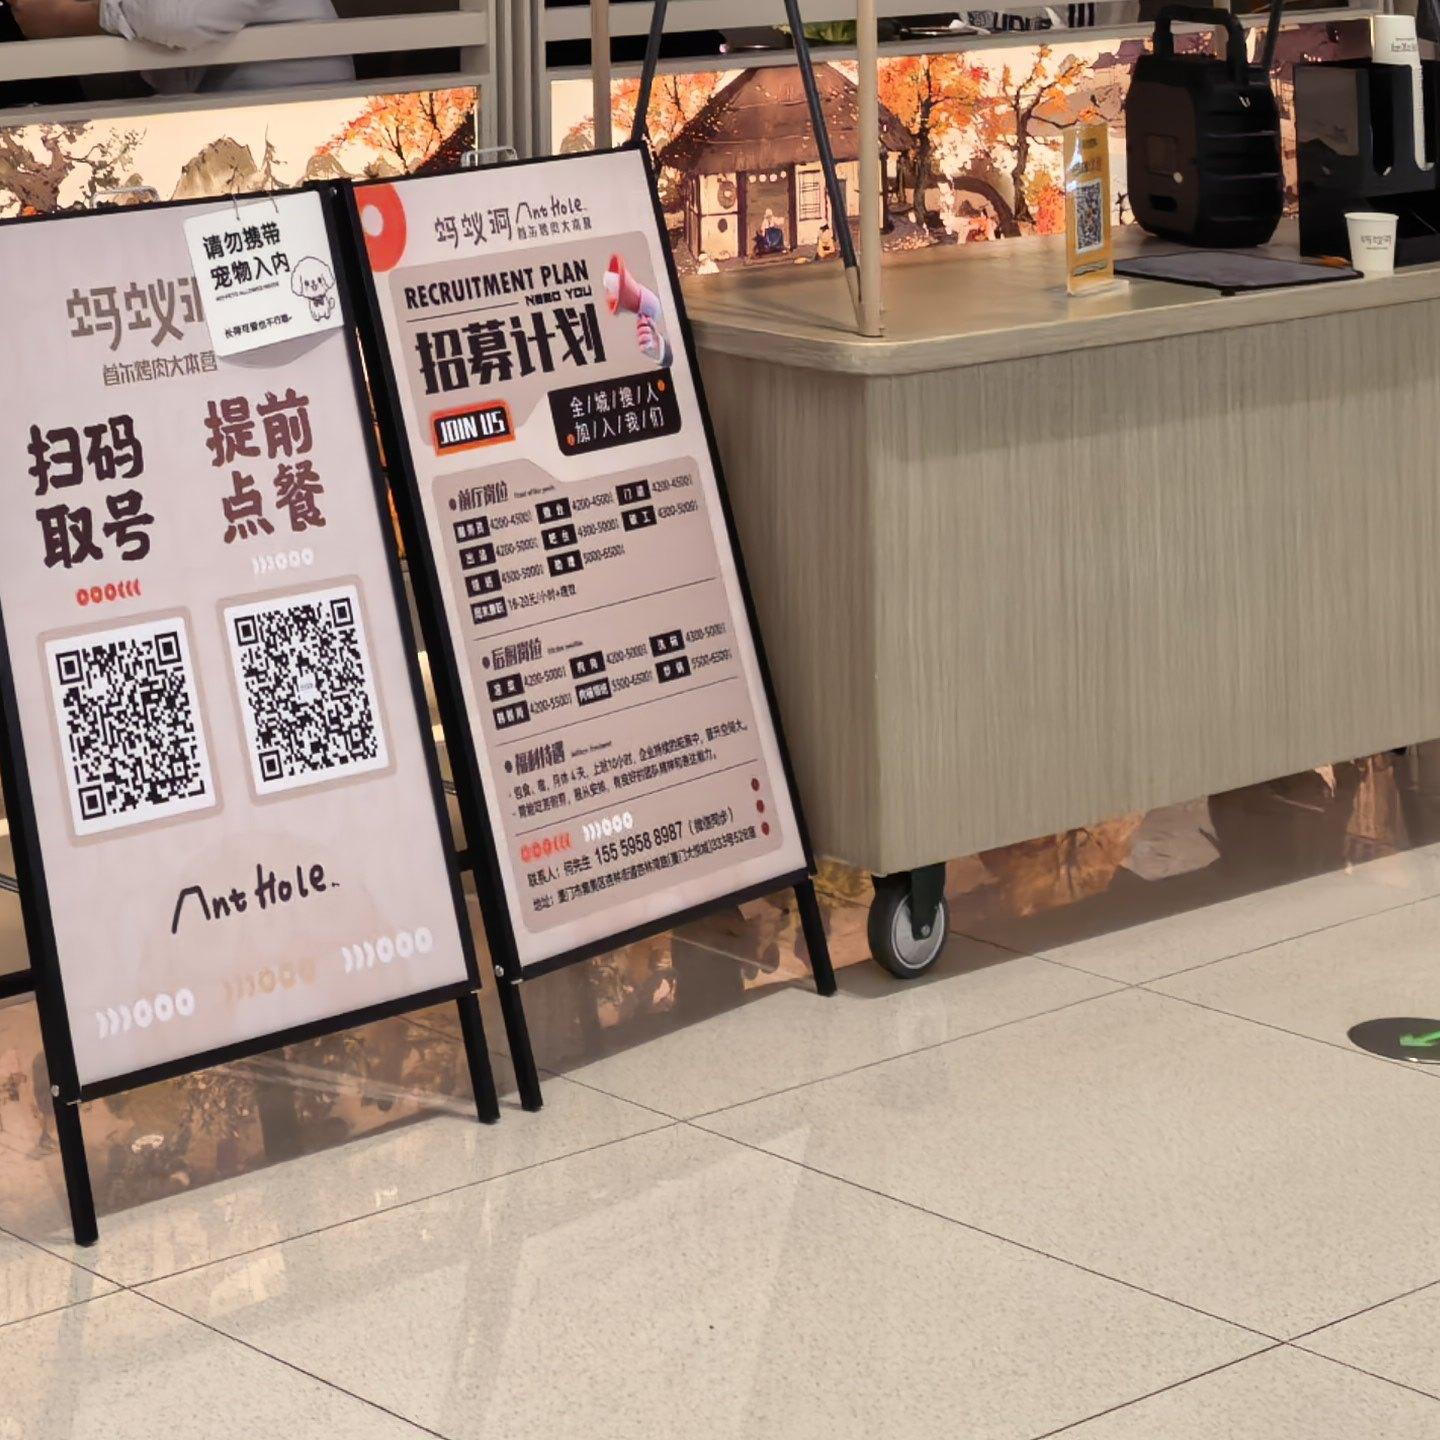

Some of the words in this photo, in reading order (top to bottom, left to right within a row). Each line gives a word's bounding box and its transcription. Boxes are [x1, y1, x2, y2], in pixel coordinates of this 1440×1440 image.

[202, 221, 282, 260] 请勿携带
[434, 206, 513, 249] 蚂蚁洞
[210, 250, 291, 291] 宠物入内
[404, 267, 535, 310] RECRUITMENT
[541, 260, 589, 287] PLAN
[563, 286, 593, 301] YOU
[102, 350, 219, 387] 首尔烤肉大本营
[415, 302, 607, 396] 招募计划
[203, 388, 313, 466] 提前
[439, 414, 477, 445] JOIN
[479, 410, 507, 436] US
[26, 413, 145, 498] 扫码
[221, 461, 327, 545] 点餐
[39, 489, 155, 573] 取号
[512, 740, 567, 776] 福利待遇
[594, 843, 619, 867] 155
[618, 831, 653, 858] 5958
[651, 820, 685, 847] 8987
